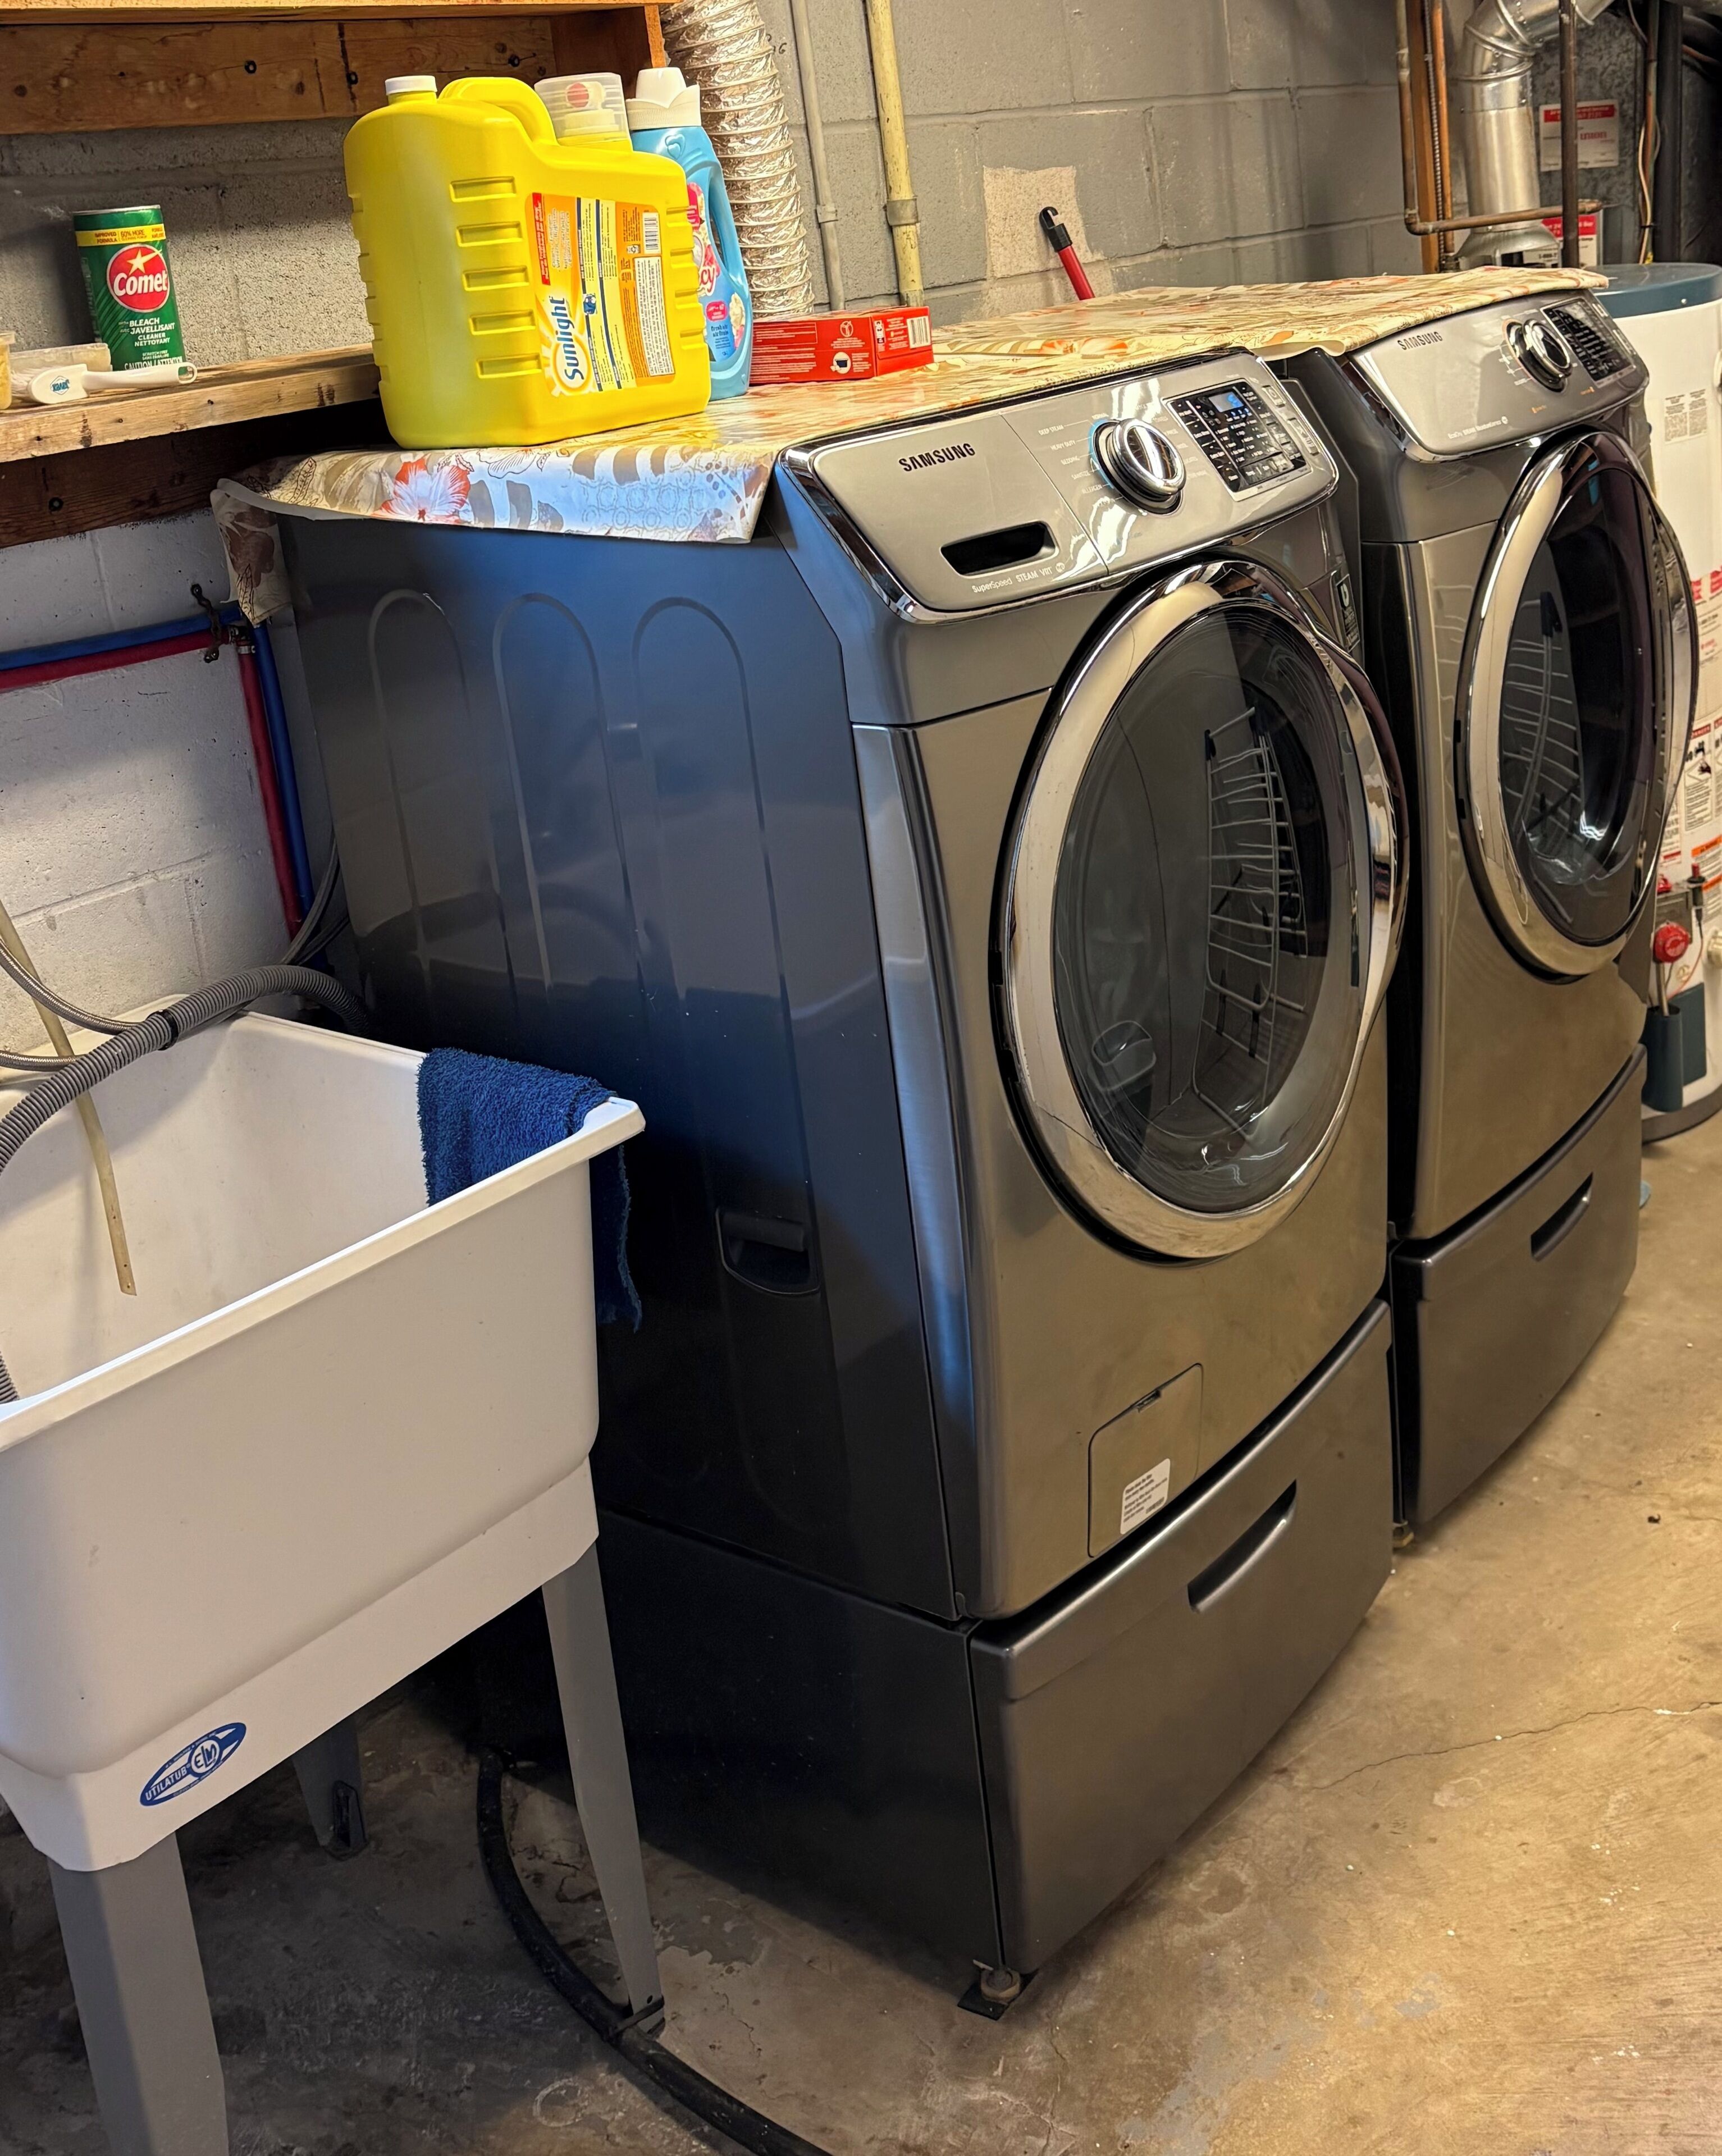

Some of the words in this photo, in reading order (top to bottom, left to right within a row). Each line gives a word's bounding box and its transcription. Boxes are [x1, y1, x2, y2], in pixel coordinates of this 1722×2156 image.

[113, 270, 168, 296] Comet
[129, 317, 160, 327] BLEACH
[130, 322, 175, 335] JAVELLISANT
[134, 337, 171, 347] NETTOYANT
[138, 332, 166, 341] CLEANER
[549, 296, 584, 380] Sunlight
[1397, 331, 1443, 350] SAMSUNG
[898, 443, 976, 472] SAMSUNG
[972, 577, 1013, 593] SuperSpeed
[1016, 570, 1039, 583] STEAM
[1039, 567, 1053, 576] VRT
[145, 1767, 188, 1801] UTILATUB
